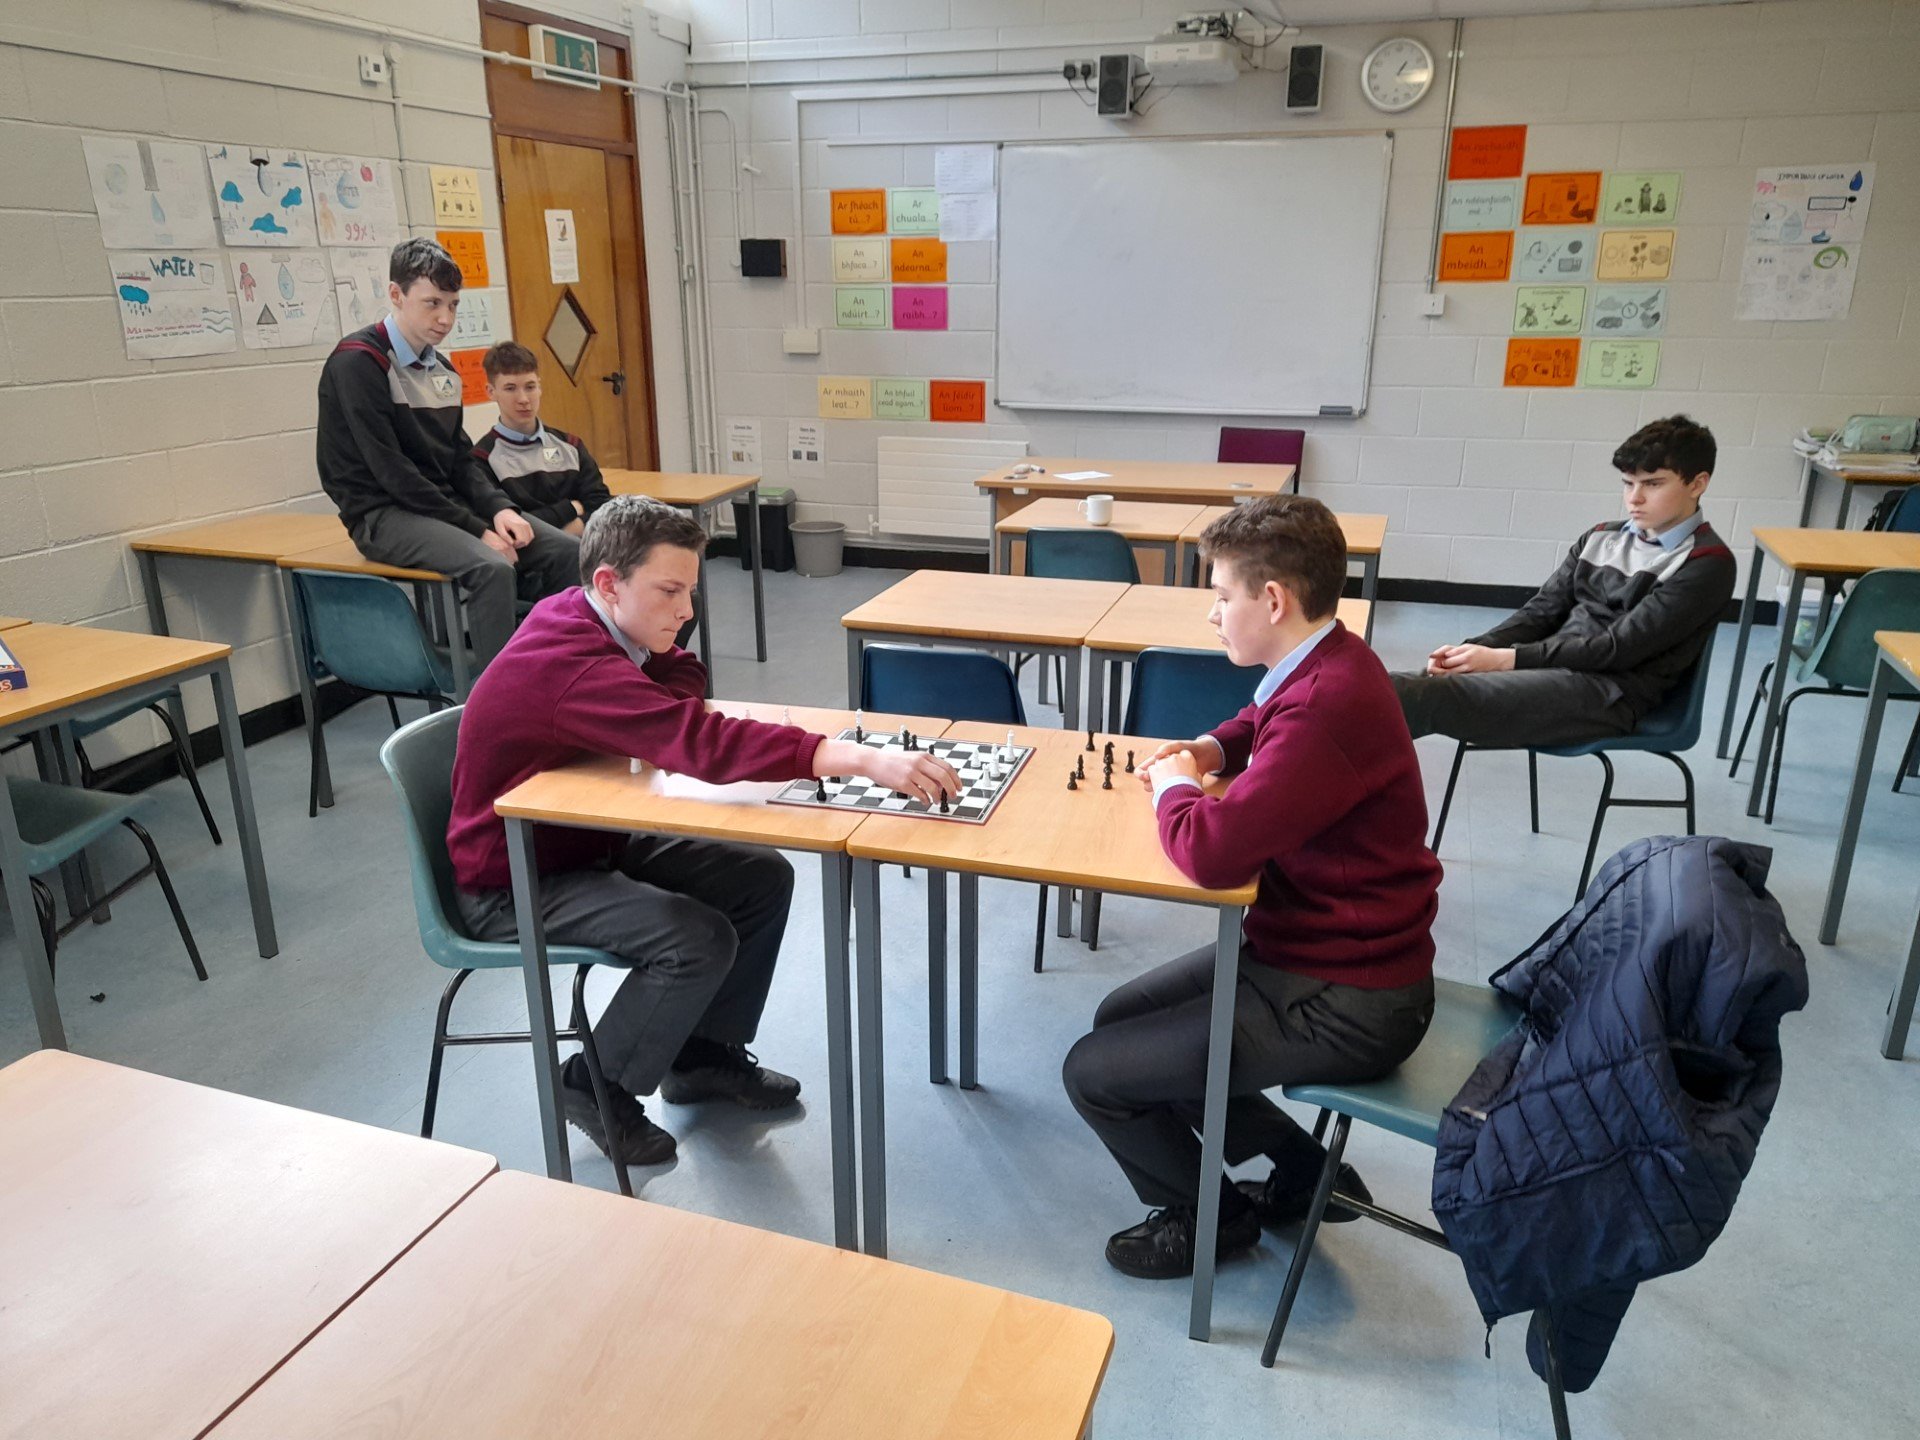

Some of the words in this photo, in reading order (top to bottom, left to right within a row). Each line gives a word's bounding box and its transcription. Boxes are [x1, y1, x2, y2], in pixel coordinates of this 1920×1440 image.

[837, 202, 847, 210] Ar
[849, 200, 879, 211] fhéach
[912, 200, 922, 208] Ar
[1451, 197, 1463, 205] An
[853, 249, 865, 257] An
[912, 249, 924, 258] An
[1469, 245, 1484, 253] An
[149, 256, 196, 278] WATER
[853, 296, 865, 305] An
[912, 297, 924, 306] An
[823, 387, 832, 396] Ar
[834, 387, 866, 397] mhaith
[895, 389, 915, 398] bhfuil
[938, 391, 950, 399] An
[878, 398, 894, 406] cead
